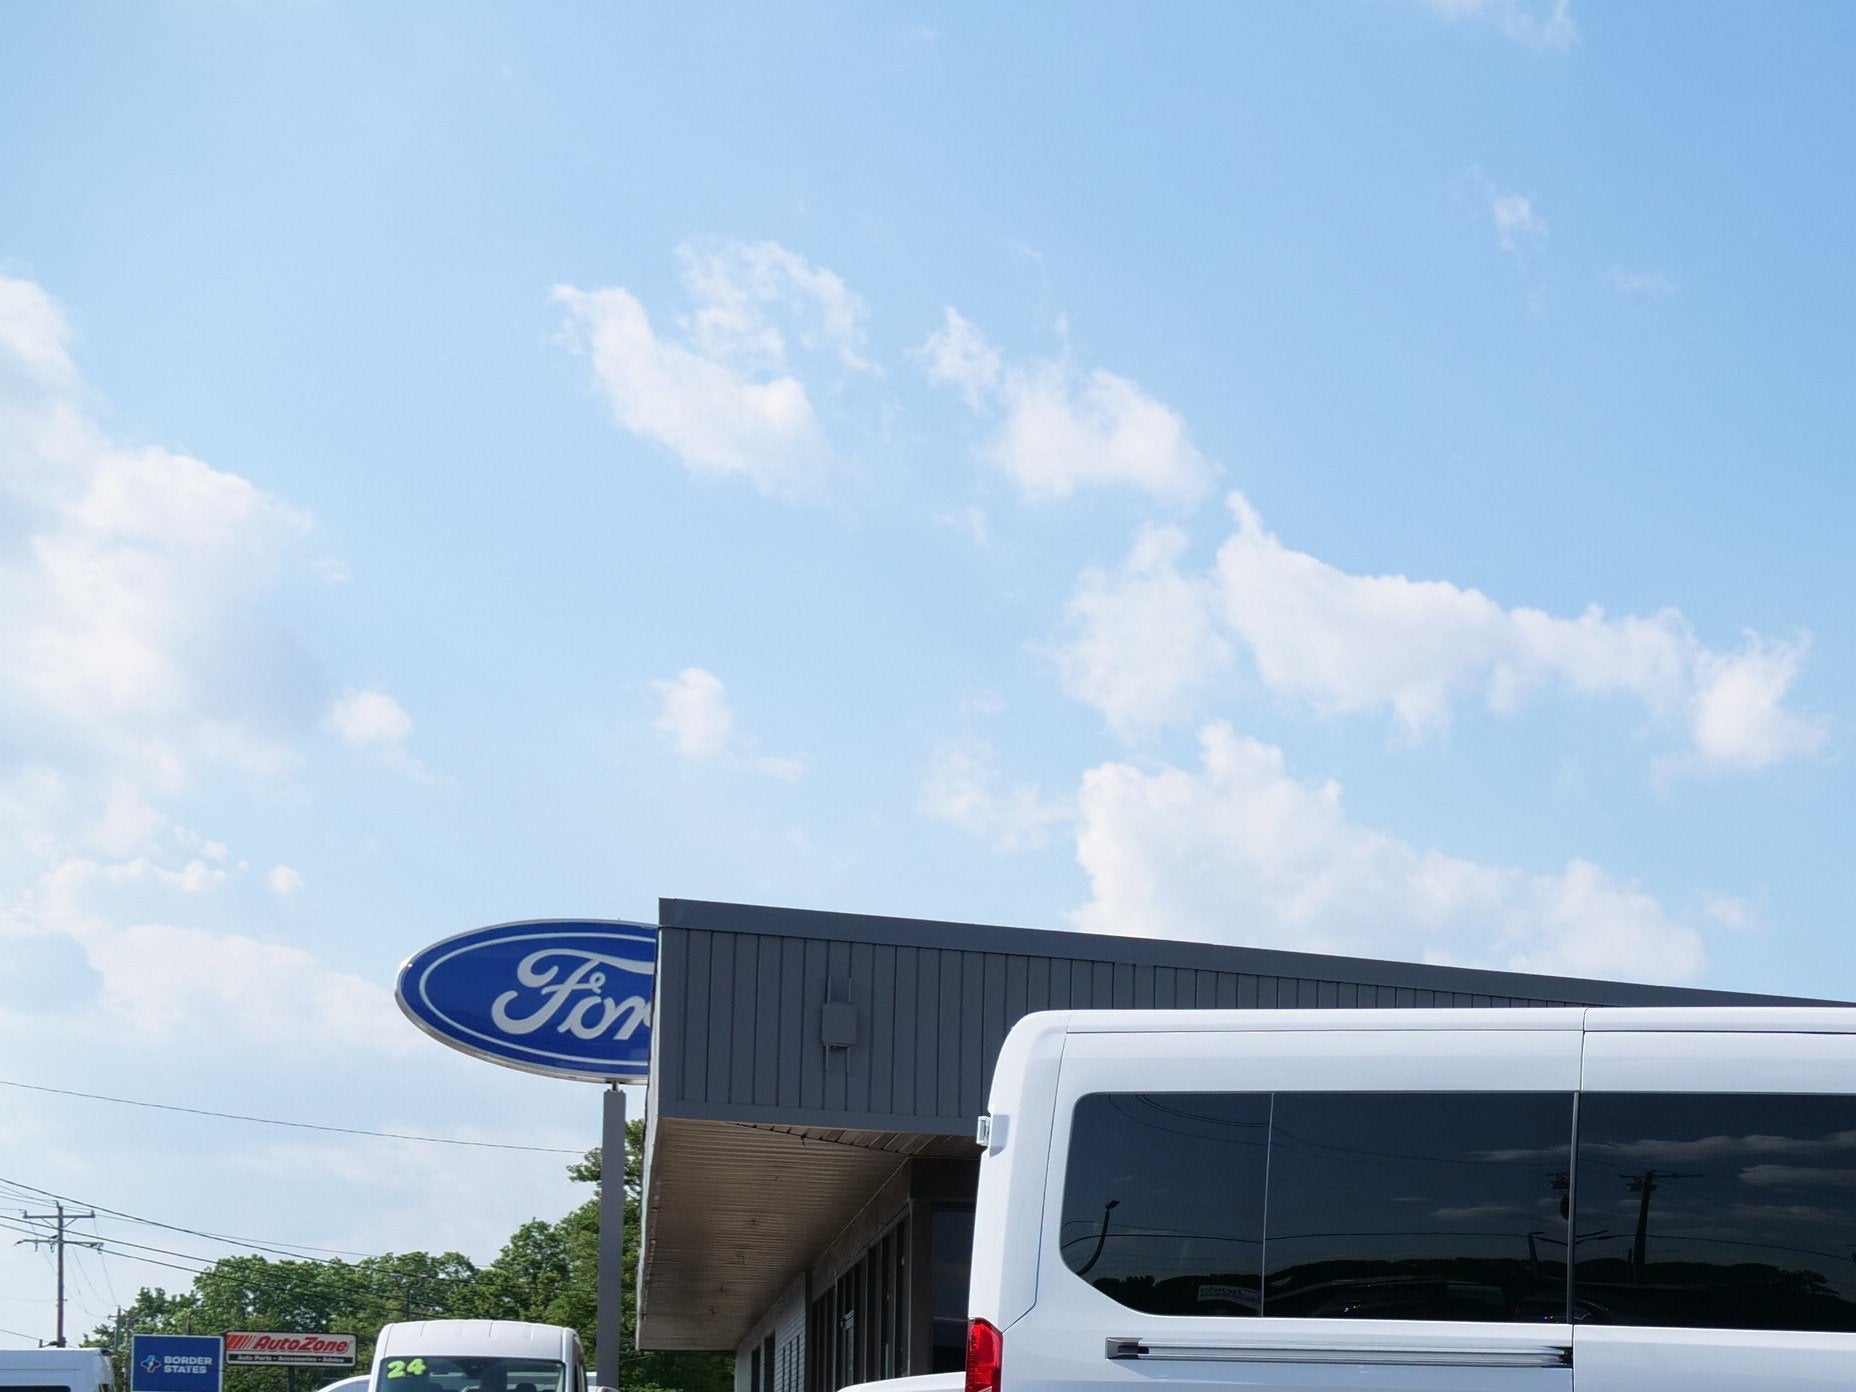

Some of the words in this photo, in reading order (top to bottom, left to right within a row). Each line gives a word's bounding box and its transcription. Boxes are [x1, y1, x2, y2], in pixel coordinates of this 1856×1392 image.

[491, 948, 656, 1040] For
[253, 1335, 349, 1354] AutoZone
[163, 1355, 213, 1365] BORDER
[163, 1365, 207, 1374] STATES
[387, 1358, 427, 1379] 24
